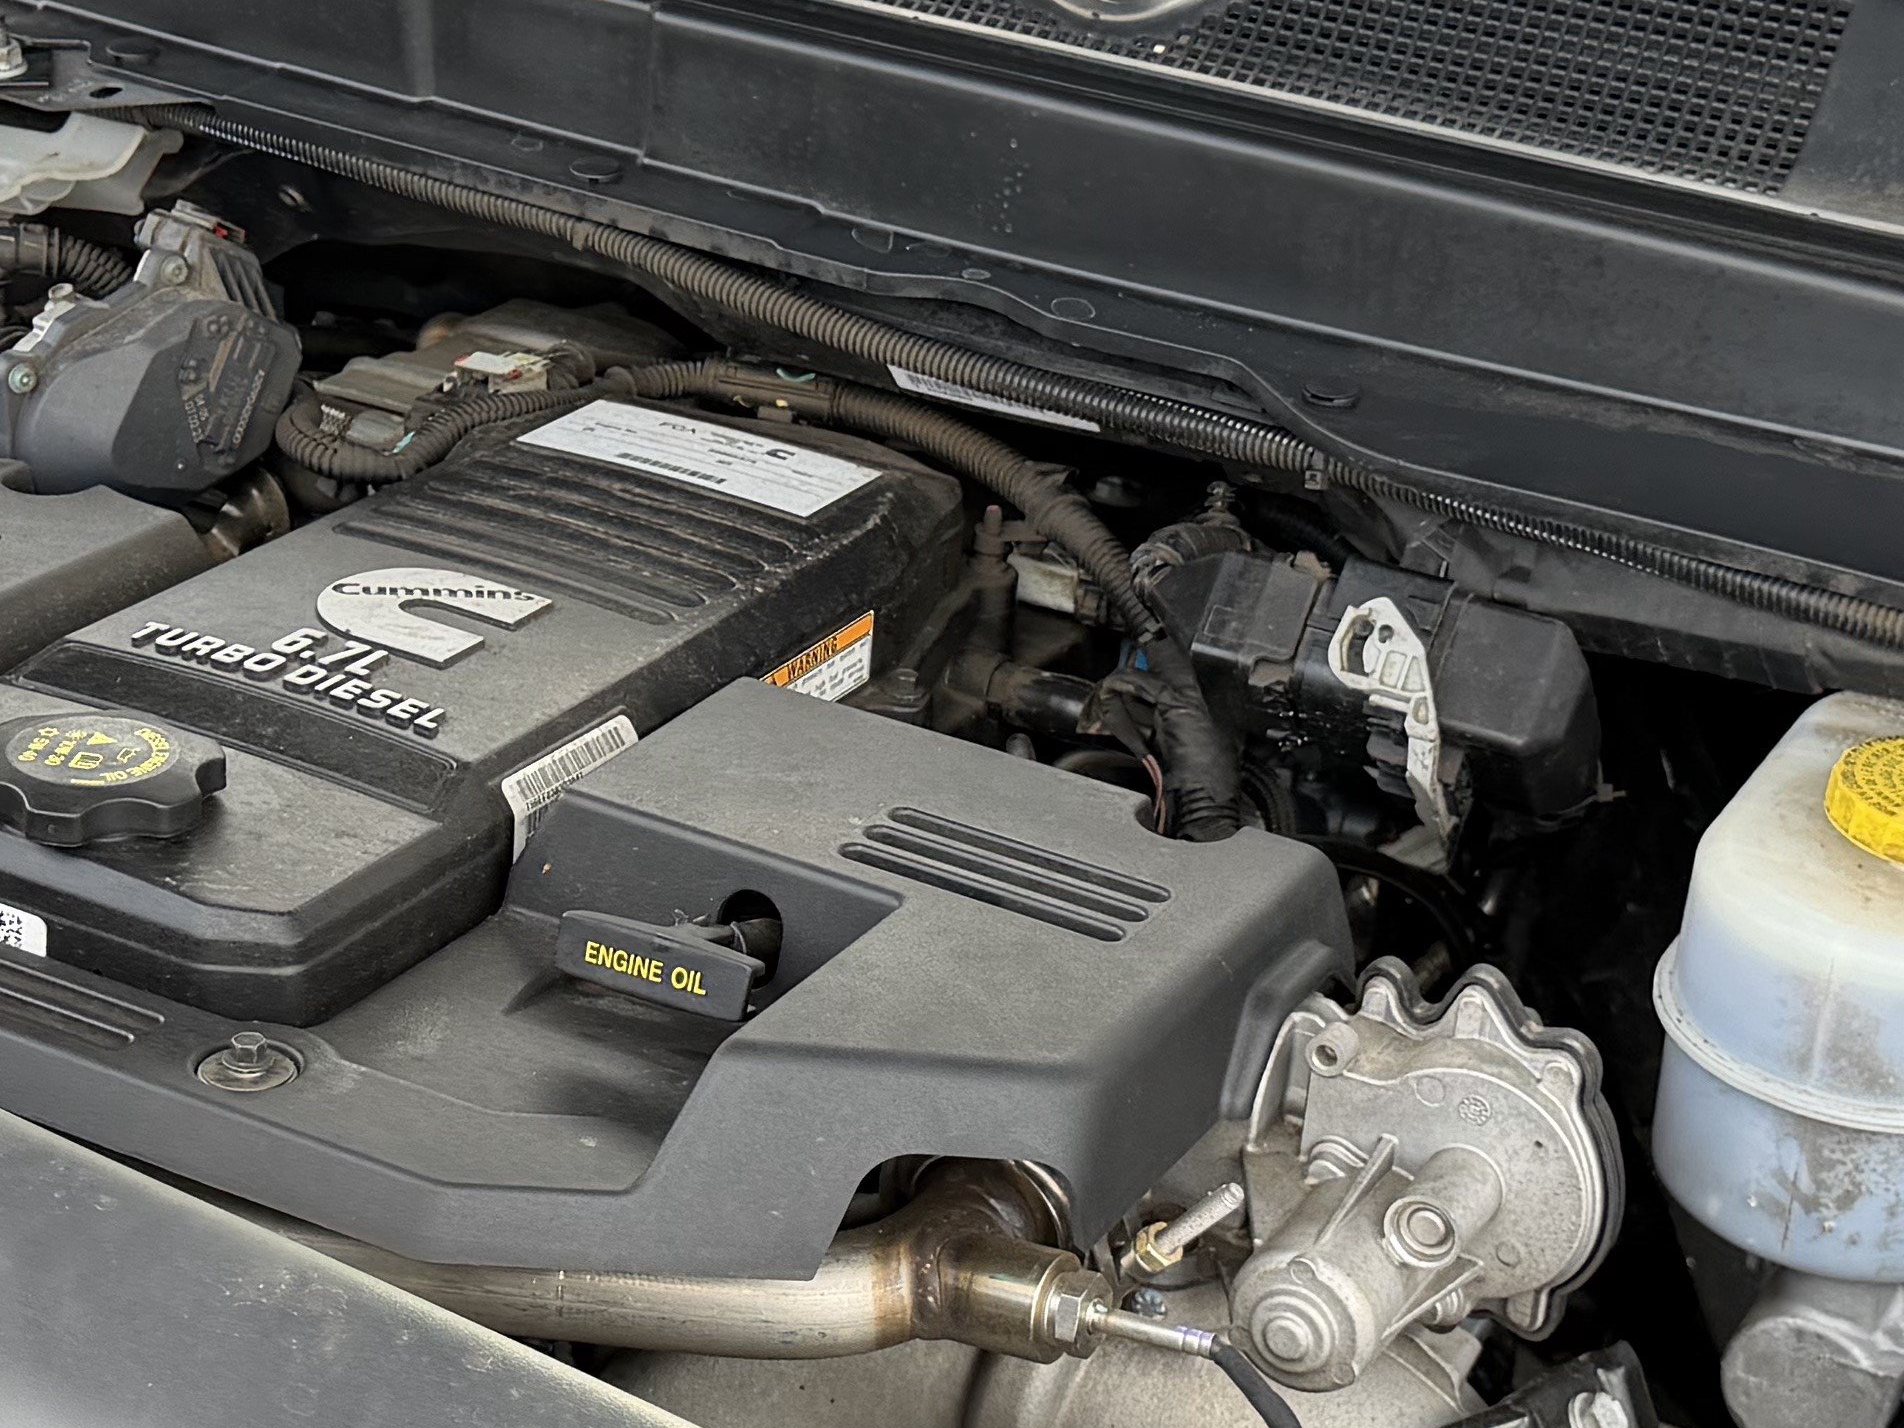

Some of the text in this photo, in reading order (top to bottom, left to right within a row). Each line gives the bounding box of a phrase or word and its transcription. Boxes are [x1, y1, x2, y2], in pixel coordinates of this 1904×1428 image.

[330, 581, 536, 603] Cummins
[271, 628, 389, 676] 6.7L
[787, 635, 838, 680] WARNING
[132, 621, 445, 731] TURBO DIESEL
[99, 770, 128, 781] OIL
[584, 940, 707, 996] ENGINE OIL
